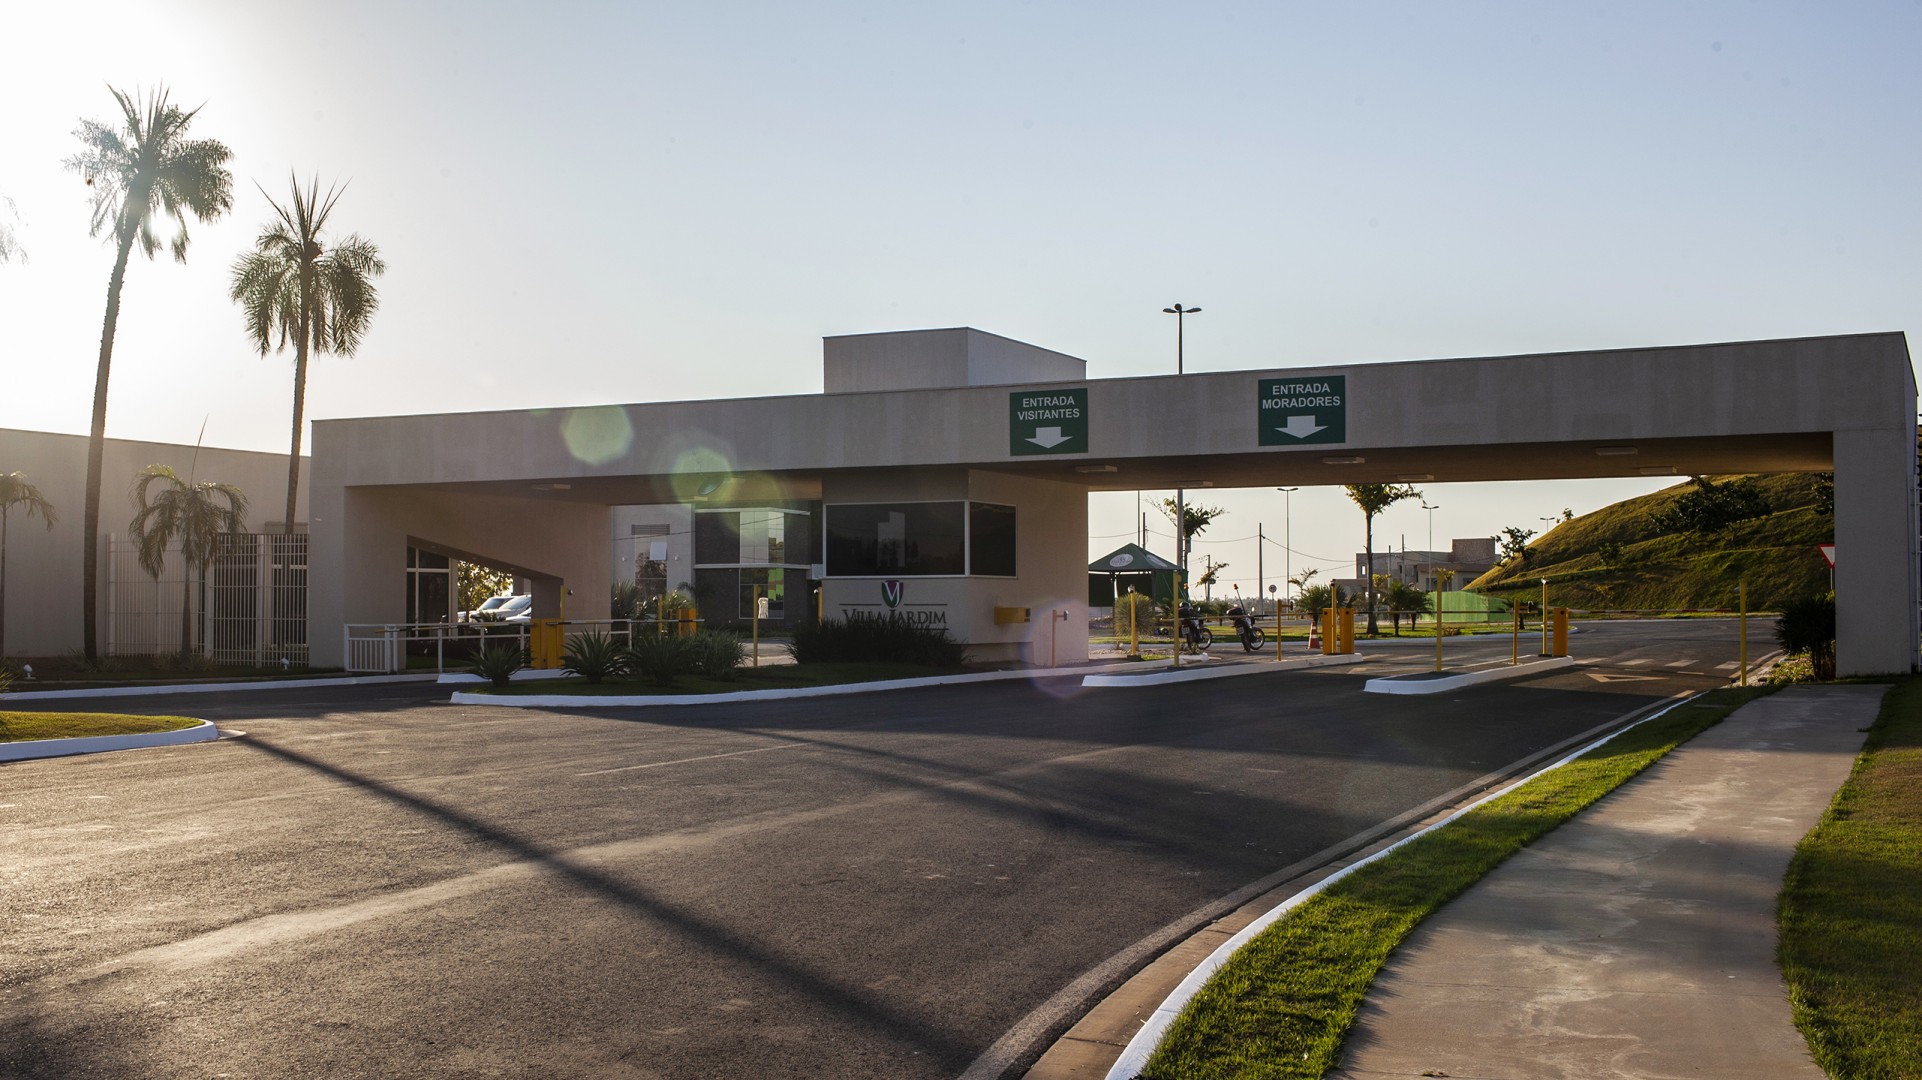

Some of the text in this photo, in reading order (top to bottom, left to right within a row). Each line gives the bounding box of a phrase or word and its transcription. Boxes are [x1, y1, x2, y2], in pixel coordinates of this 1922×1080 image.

[1272, 382, 1331, 396] ENTRADA
[1022, 395, 1075, 408] ENTRADA
[1262, 395, 1341, 410] MORADORES
[1017, 408, 1080, 421] VISITANTES
